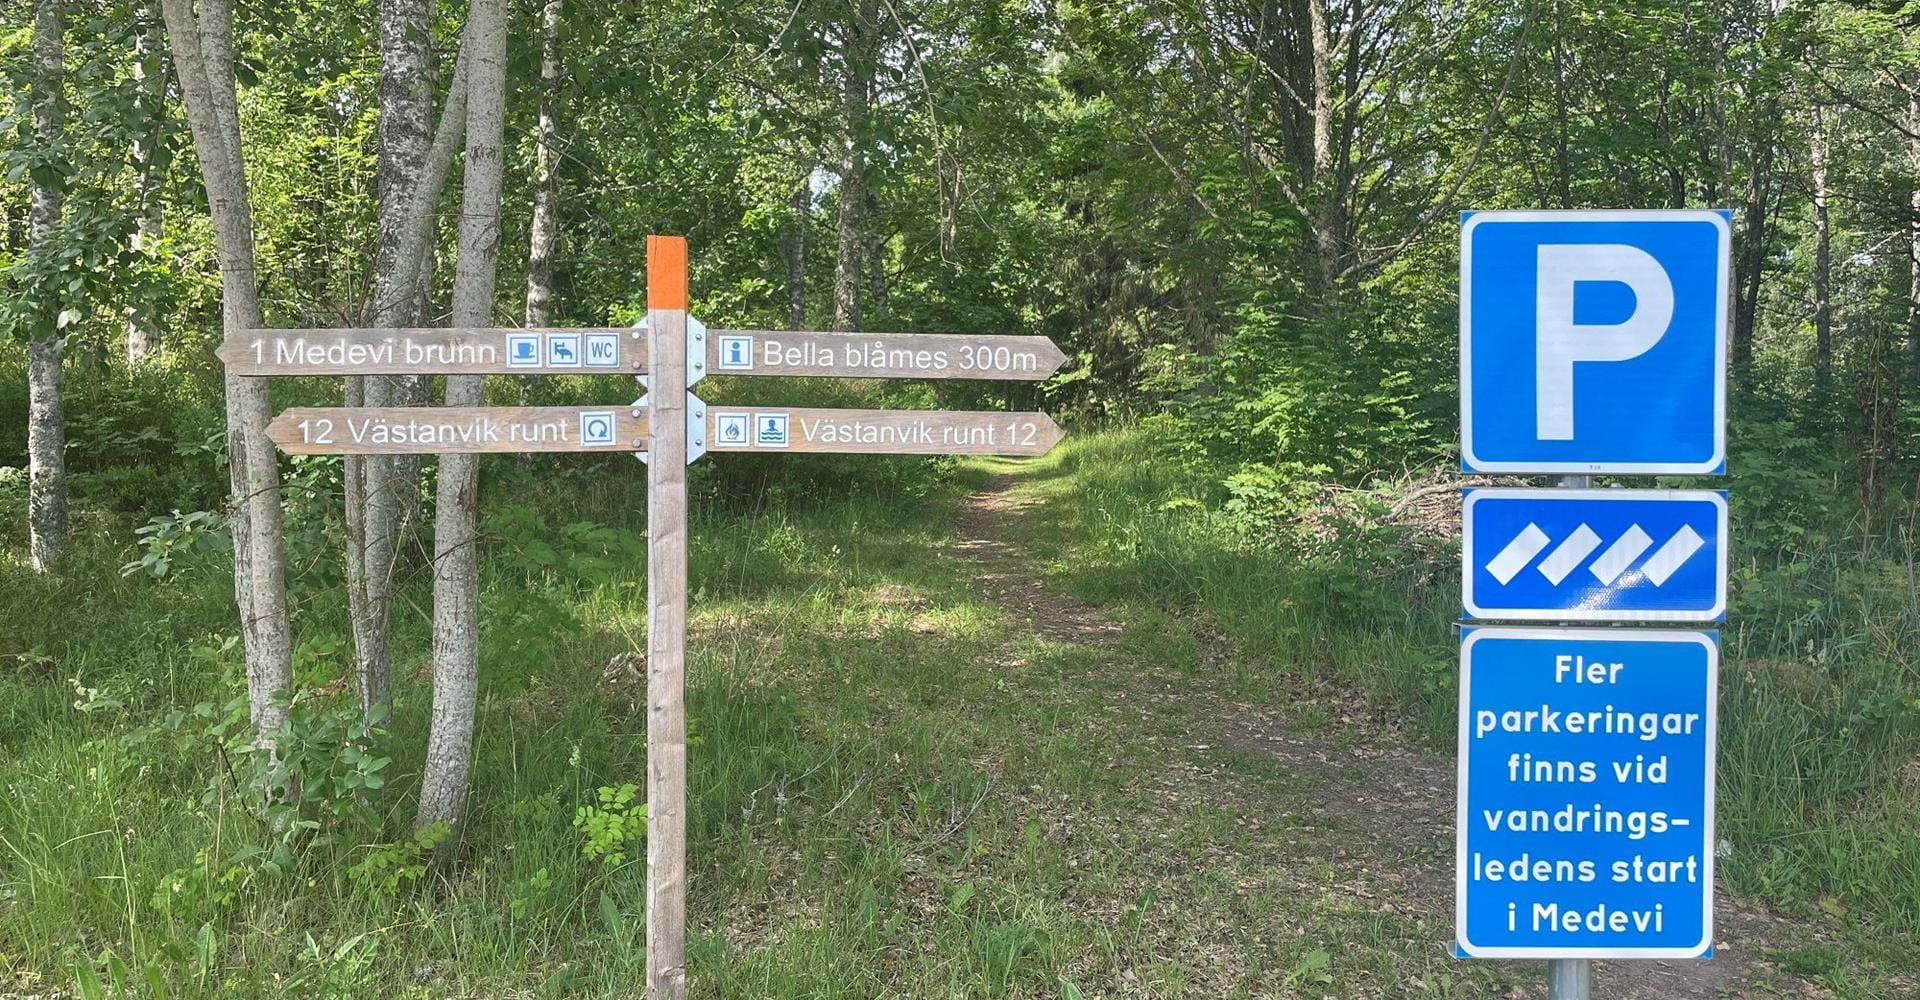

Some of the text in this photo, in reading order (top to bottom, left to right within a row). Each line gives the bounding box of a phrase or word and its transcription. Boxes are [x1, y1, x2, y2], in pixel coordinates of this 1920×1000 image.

[251, 338, 495, 365] 1 Medevi brunn
[592, 343, 612, 358] WC
[765, 341, 1036, 371] Bella blåmes 300m
[1536, 244, 1674, 440] P
[298, 417, 569, 444] 12 Västanvik runt
[799, 418, 1036, 445] Västanvik runt 12
[1556, 656, 1623, 683] Fler
[1477, 705, 1698, 740] parkeringar
[1508, 753, 1666, 783] finns vid
[1484, 804, 1689, 839] vandrings-
[1475, 853, 1696, 882] ledens start
[1508, 903, 1662, 931] i Medevi
